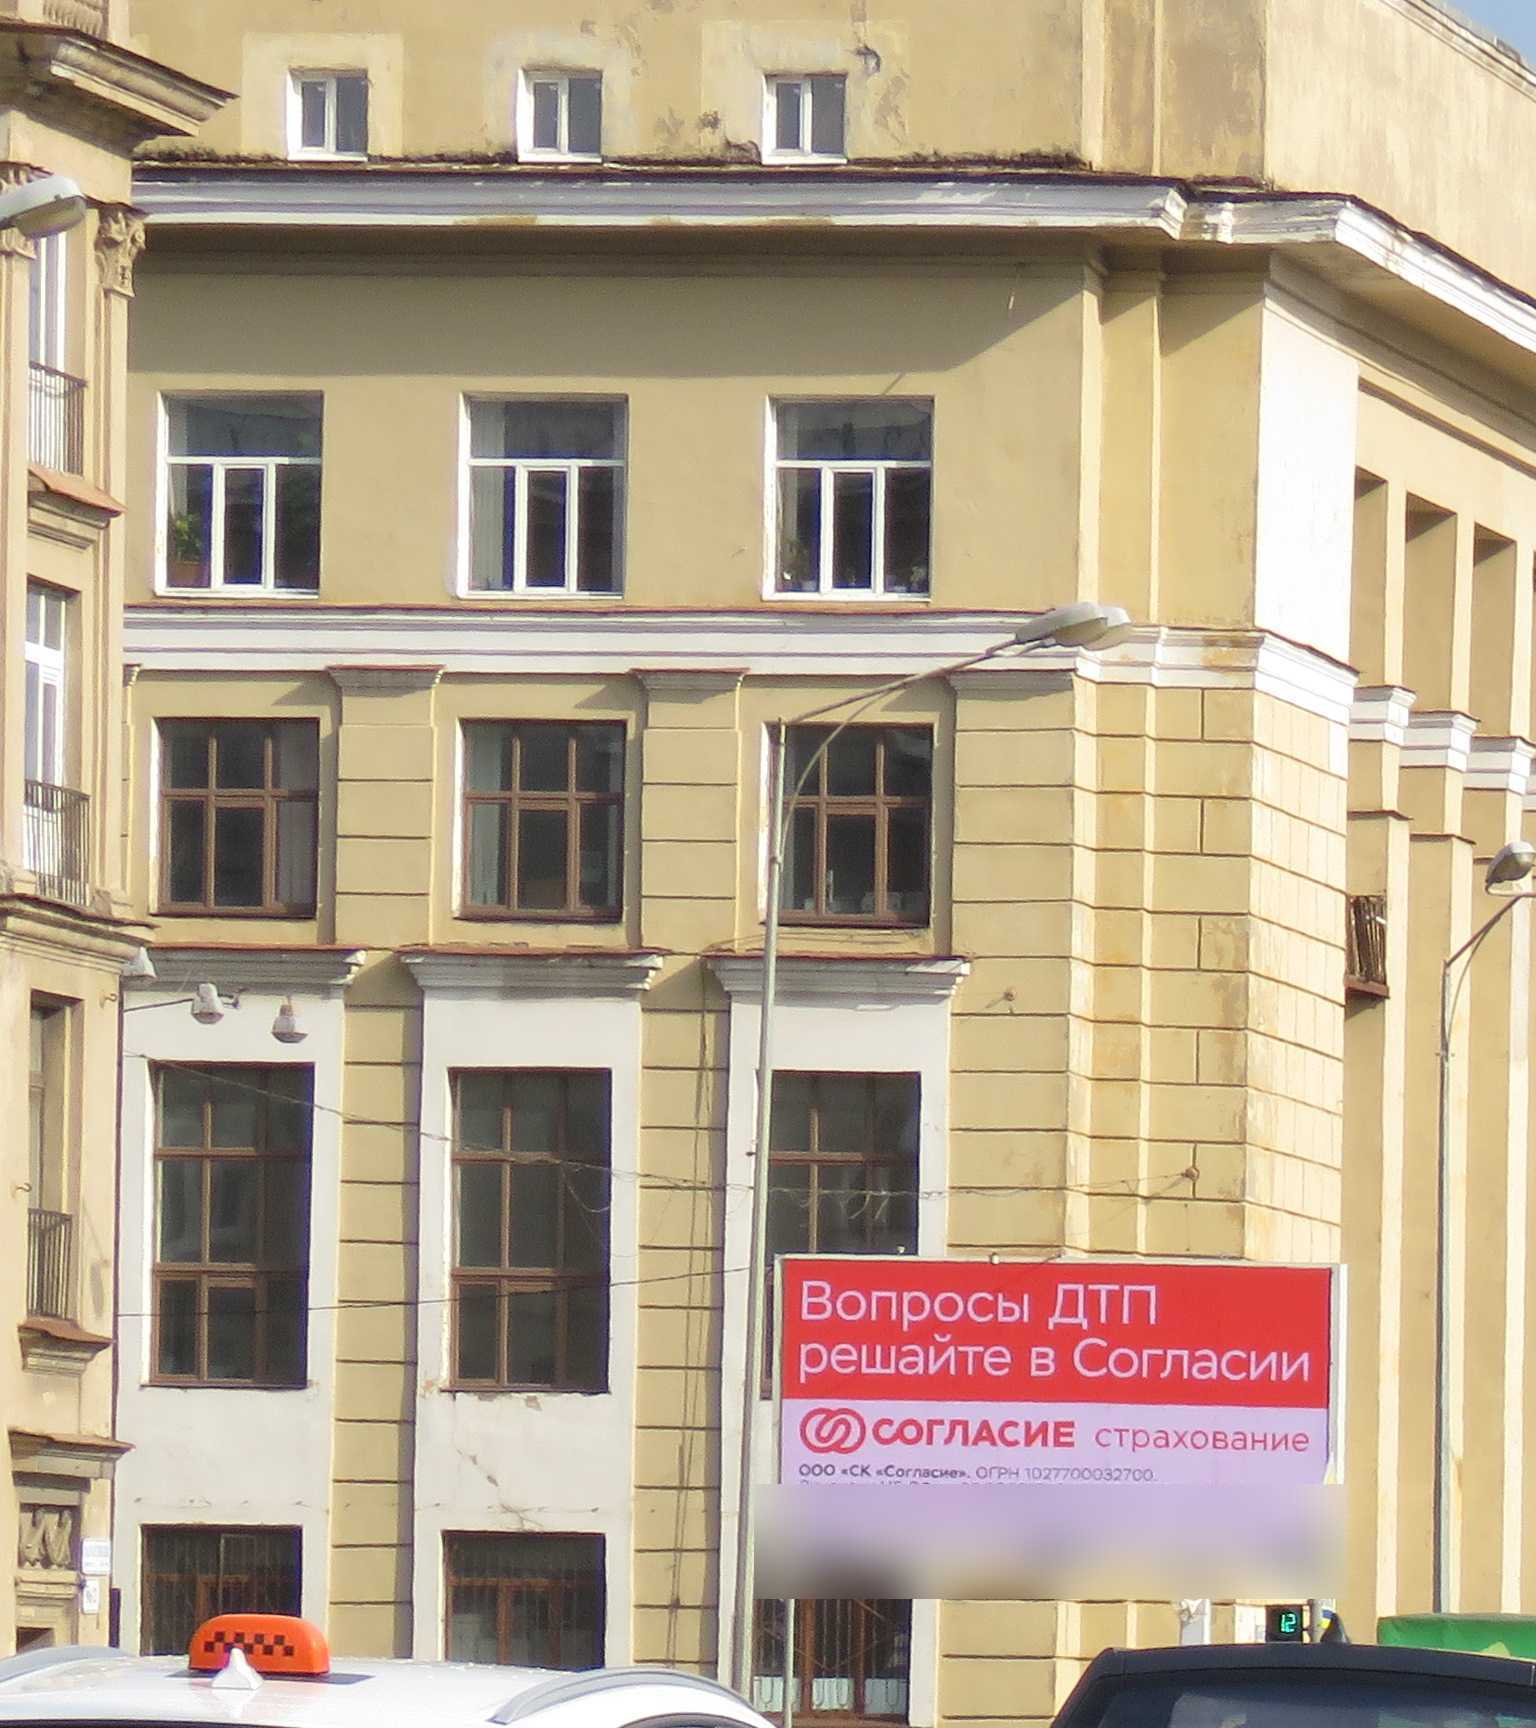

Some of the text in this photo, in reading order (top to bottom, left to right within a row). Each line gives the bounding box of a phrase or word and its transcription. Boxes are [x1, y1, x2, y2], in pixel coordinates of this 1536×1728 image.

[800, 1280, 1158, 1330] Вопросы ДТП
[799, 1333, 1310, 1383] решайте в Согласии
[872, 1416, 1310, 1453] СОГЛАСИЕ страхование
[799, 1464, 836, 1477] ООО
[976, 1467, 1019, 1480] ОГРН
